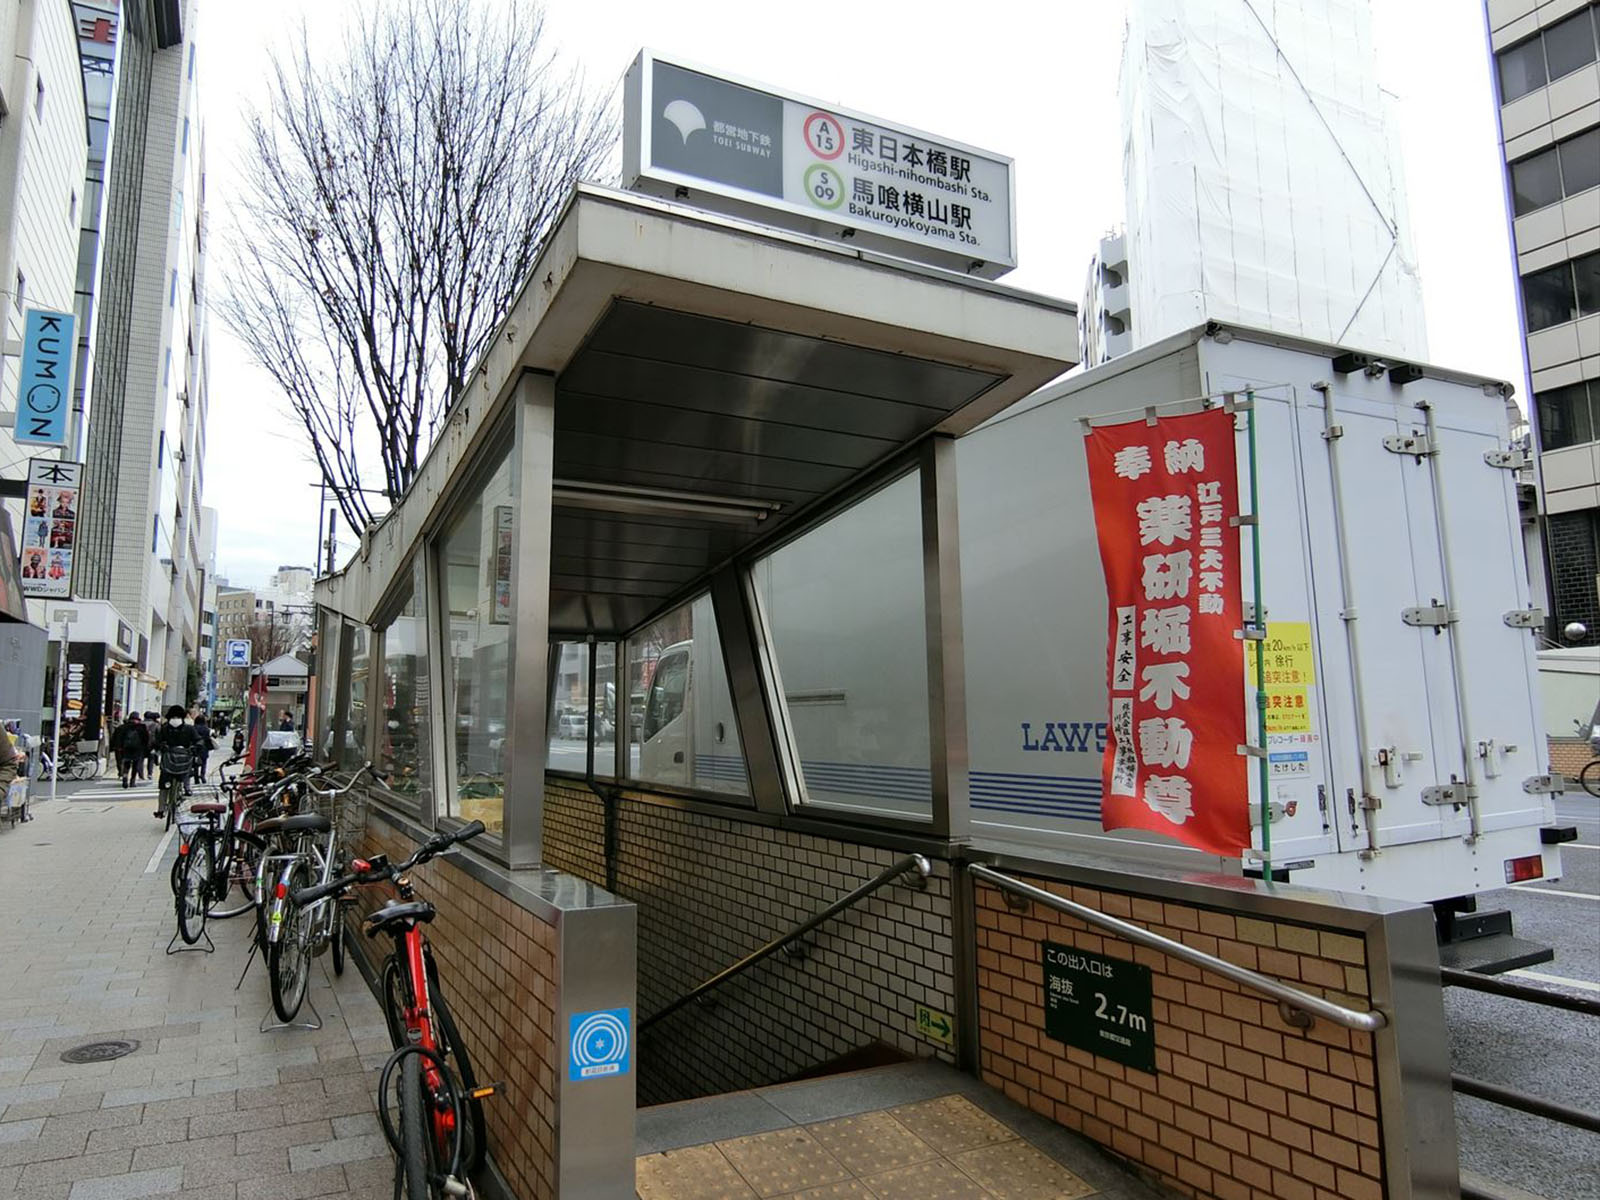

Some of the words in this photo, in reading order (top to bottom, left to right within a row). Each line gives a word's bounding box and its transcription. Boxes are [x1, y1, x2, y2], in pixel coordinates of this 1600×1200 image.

[713, 121, 772, 147] 都営地下鉄
[816, 135, 833, 150] 15
[819, 122, 829, 134] A
[713, 134, 733, 147] TOEI
[736, 141, 770, 158] SUBWAY
[852, 127, 972, 183] 東日本橋駅
[815, 185, 834, 200] 09
[821, 172, 829, 184] S
[848, 152, 968, 196] Higashi-nihombashi
[971, 187, 992, 203] Sta.
[852, 177, 972, 230] 馬喰横山駅
[849, 203, 955, 239] Bakuroyokoyama
[959, 231, 981, 246] Sta.
[27, 315, 62, 437] KUMON
[37, 464, 75, 484] 本
[1114, 438, 1205, 480] 奉納
[1196, 480, 1224, 615] 江戸三大不動
[1117, 614, 1134, 683] 工事安全
[1136, 494, 1195, 825] 薬研堀不動尊
[1021, 722, 1109, 753] LAWS
[1047, 949, 1114, 978] この出入口は
[1049, 974, 1074, 996] 海抜
[1094, 992, 1147, 1032] 2.7m
